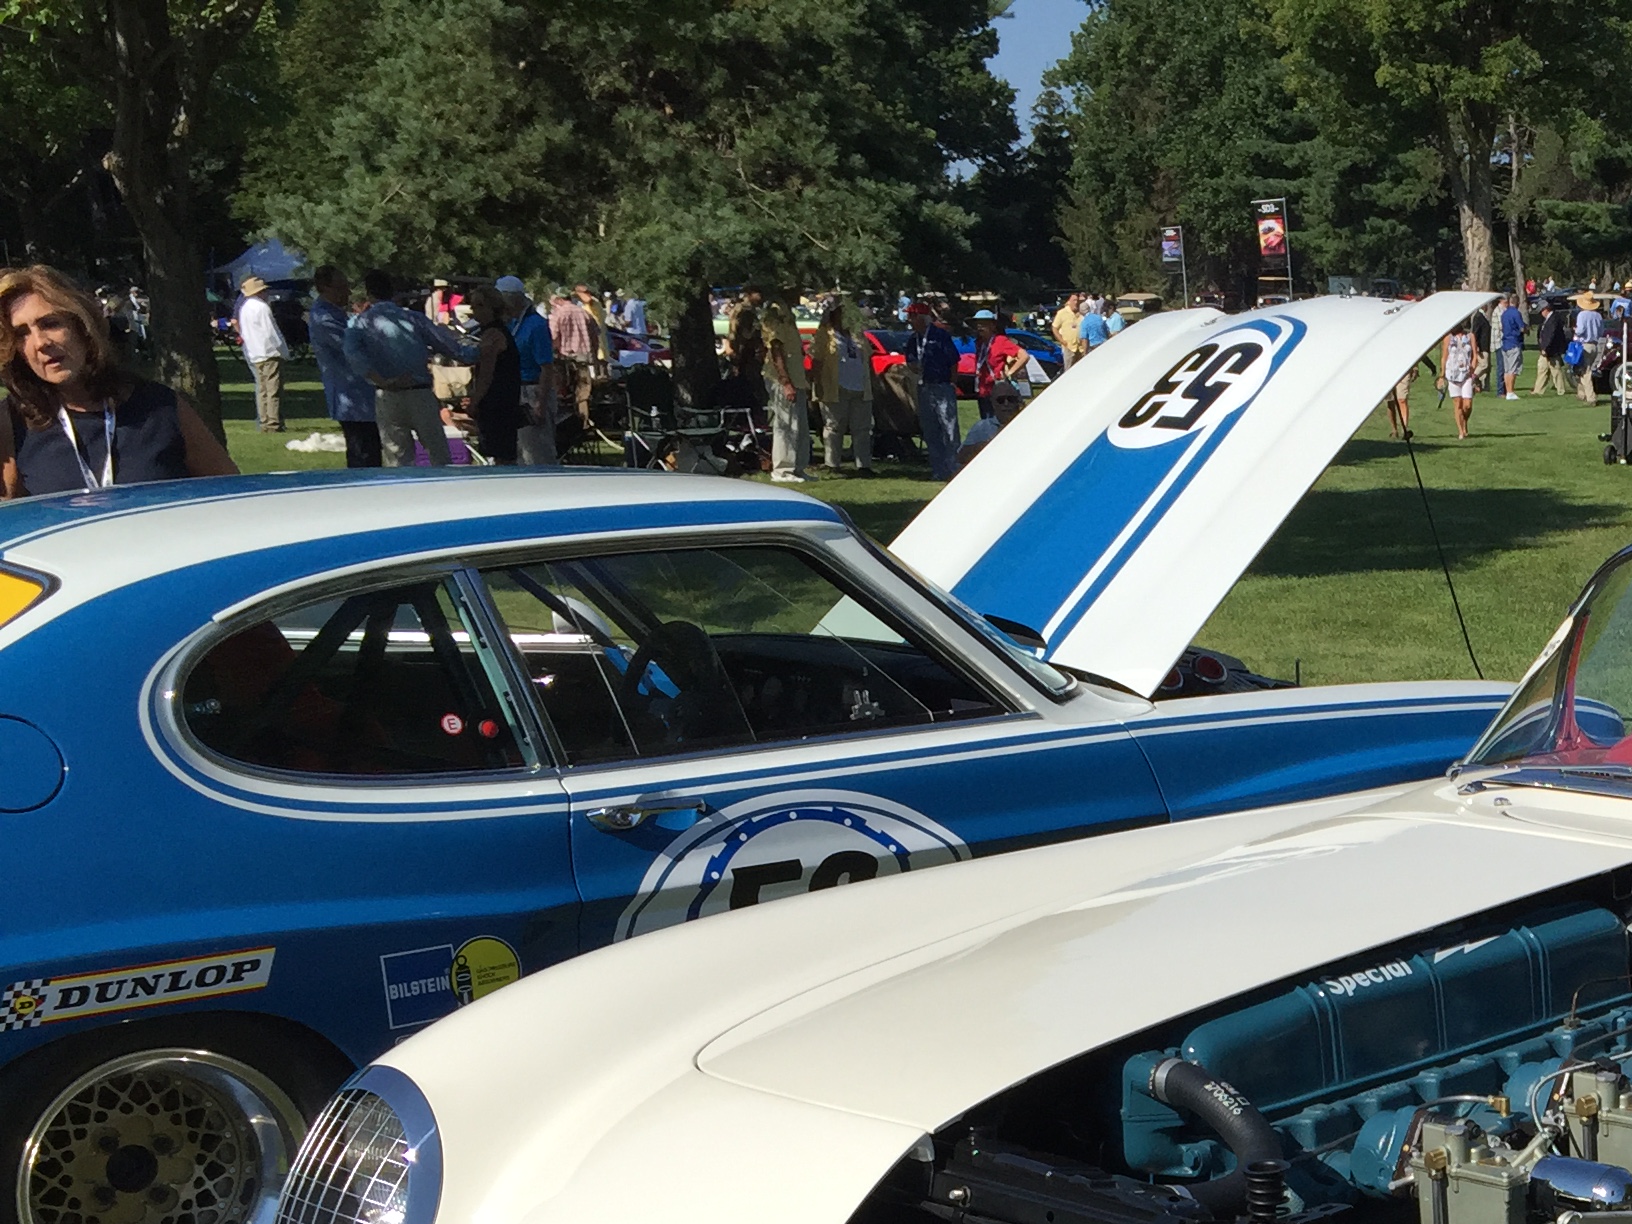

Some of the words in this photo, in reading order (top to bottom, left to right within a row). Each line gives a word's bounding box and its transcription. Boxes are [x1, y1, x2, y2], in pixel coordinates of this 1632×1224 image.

[1118, 341, 1263, 430] 53
[447, 718, 457, 730] E
[53, 958, 262, 1011] DUNLOP
[389, 974, 451, 1000] BILSTEIN
[1325, 959, 1414, 997] Special
[18, 1001, 35, 1010] D
